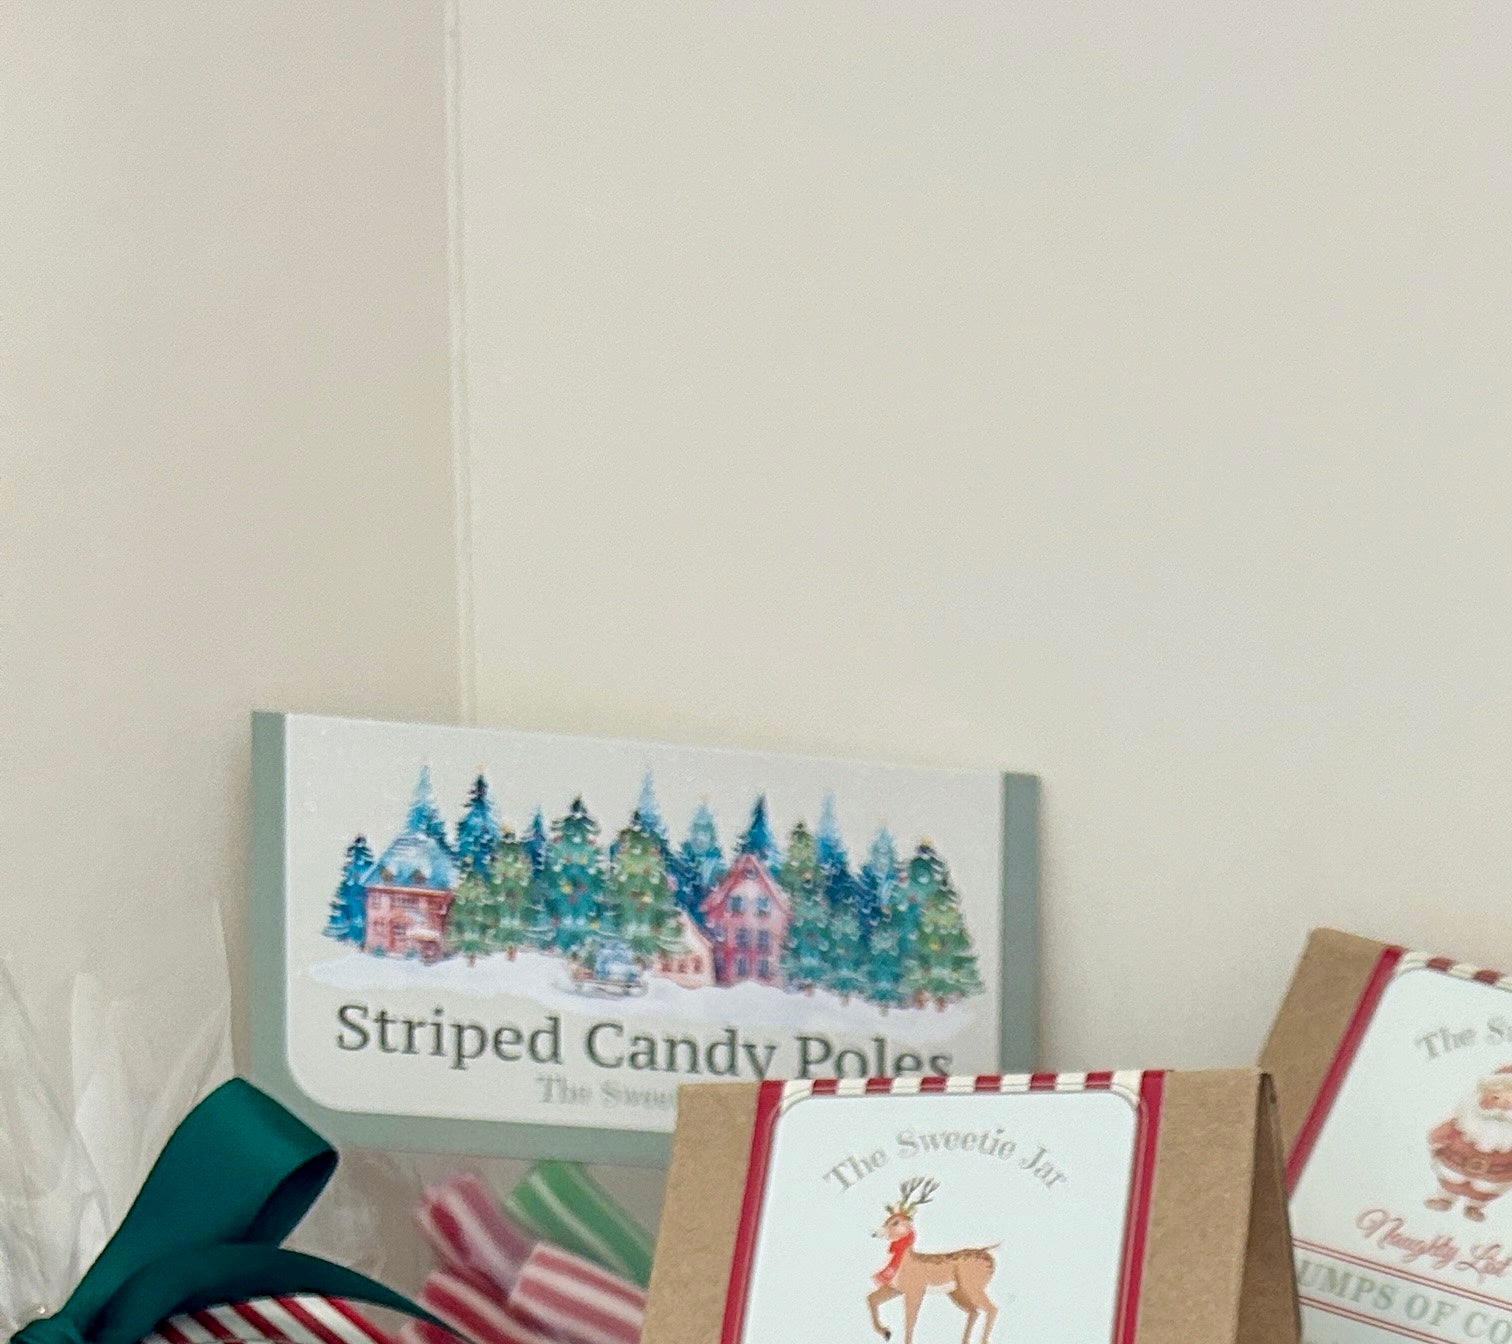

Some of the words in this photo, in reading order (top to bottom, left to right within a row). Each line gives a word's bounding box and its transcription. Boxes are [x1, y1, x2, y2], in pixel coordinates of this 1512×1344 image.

[335, 1003, 563, 1070] Striped
[585, 1021, 777, 1081] Candy
[1414, 1021, 1476, 1061] The
[538, 1074, 592, 1106] The
[822, 1145, 888, 1195] The
[895, 1127, 1018, 1162] Sweetie
[1019, 1145, 1068, 1190] Jar
[1298, 1259, 1397, 1310] UMPS
[1404, 1292, 1458, 1326] OF
